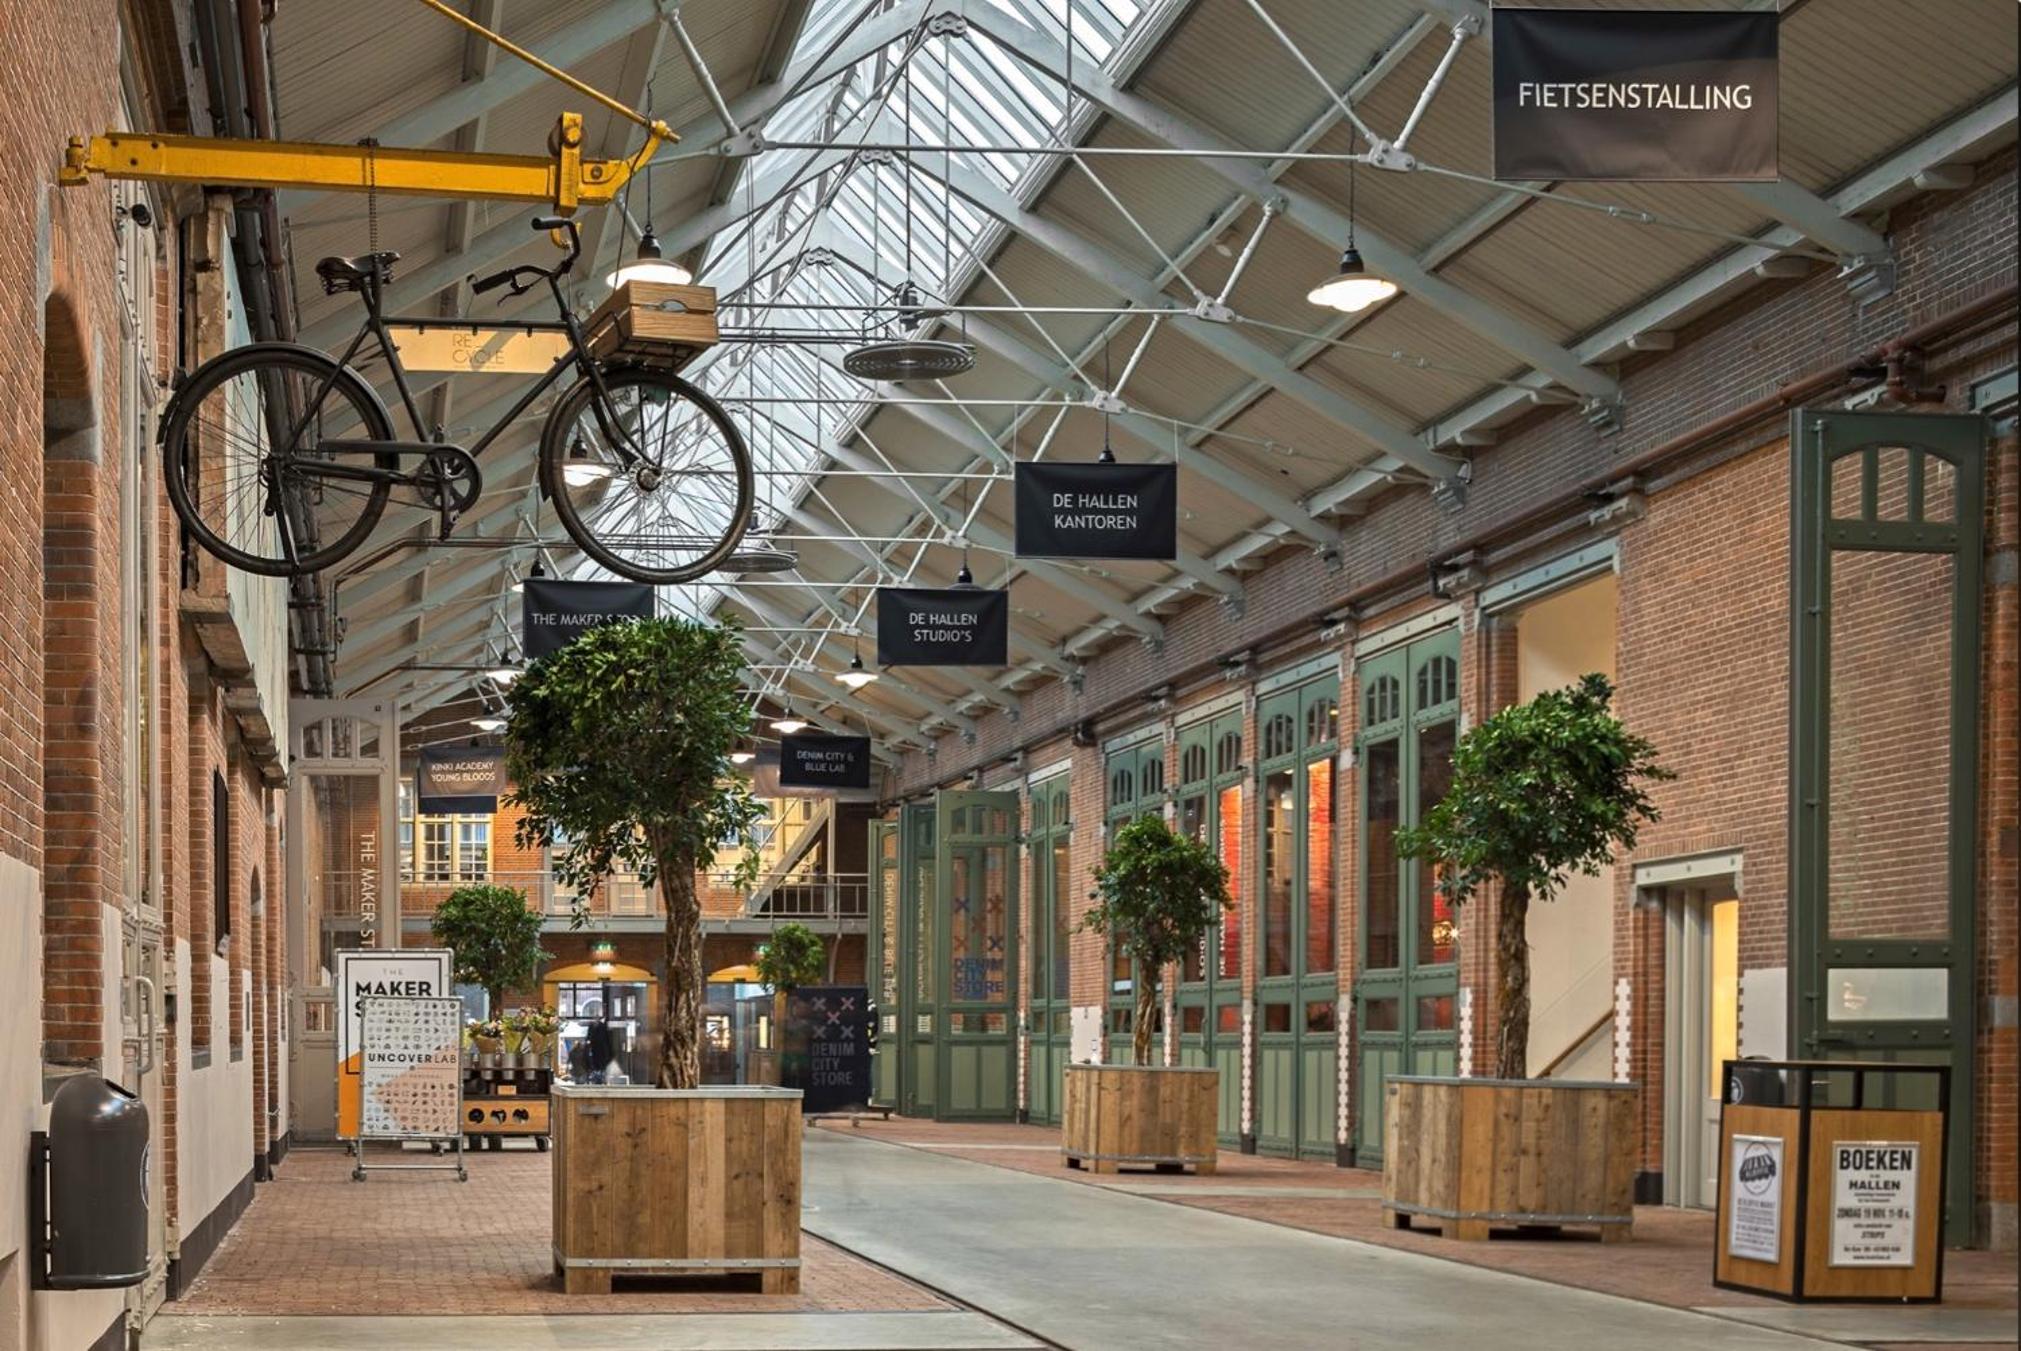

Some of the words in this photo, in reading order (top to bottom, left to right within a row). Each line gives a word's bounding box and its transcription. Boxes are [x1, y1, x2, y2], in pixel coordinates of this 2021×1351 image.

[1519, 82, 1753, 111] FIETSENSTALLING
[452, 349, 505, 364] CYCLE
[1053, 493, 1073, 508] DE
[1078, 494, 1138, 508] HALLEN
[1054, 514, 1137, 529] KANTOREN
[531, 613, 557, 625] THE
[560, 613, 603, 625] MAKER
[909, 612, 925, 625] DE
[929, 613, 978, 626] HALLEN
[914, 629, 972, 642] STUDIO'S
[797, 750, 824, 760] DENIM
[825, 751, 845, 760] CITY
[805, 761, 827, 771] BLUE
[431, 773, 460, 782] YOUNG
[462, 772, 496, 781] BLOODS
[360, 830, 376, 862] THE
[360, 868, 376, 922] MAKER
[355, 980, 432, 996] MAKER
[812, 1041, 855, 1056] DENIM
[812, 1057, 841, 1071] CITY
[812, 1071, 854, 1086] STORE
[1839, 1149, 1912, 1170] BOEKEN
[1848, 1180, 1901, 1191] HALLEN
